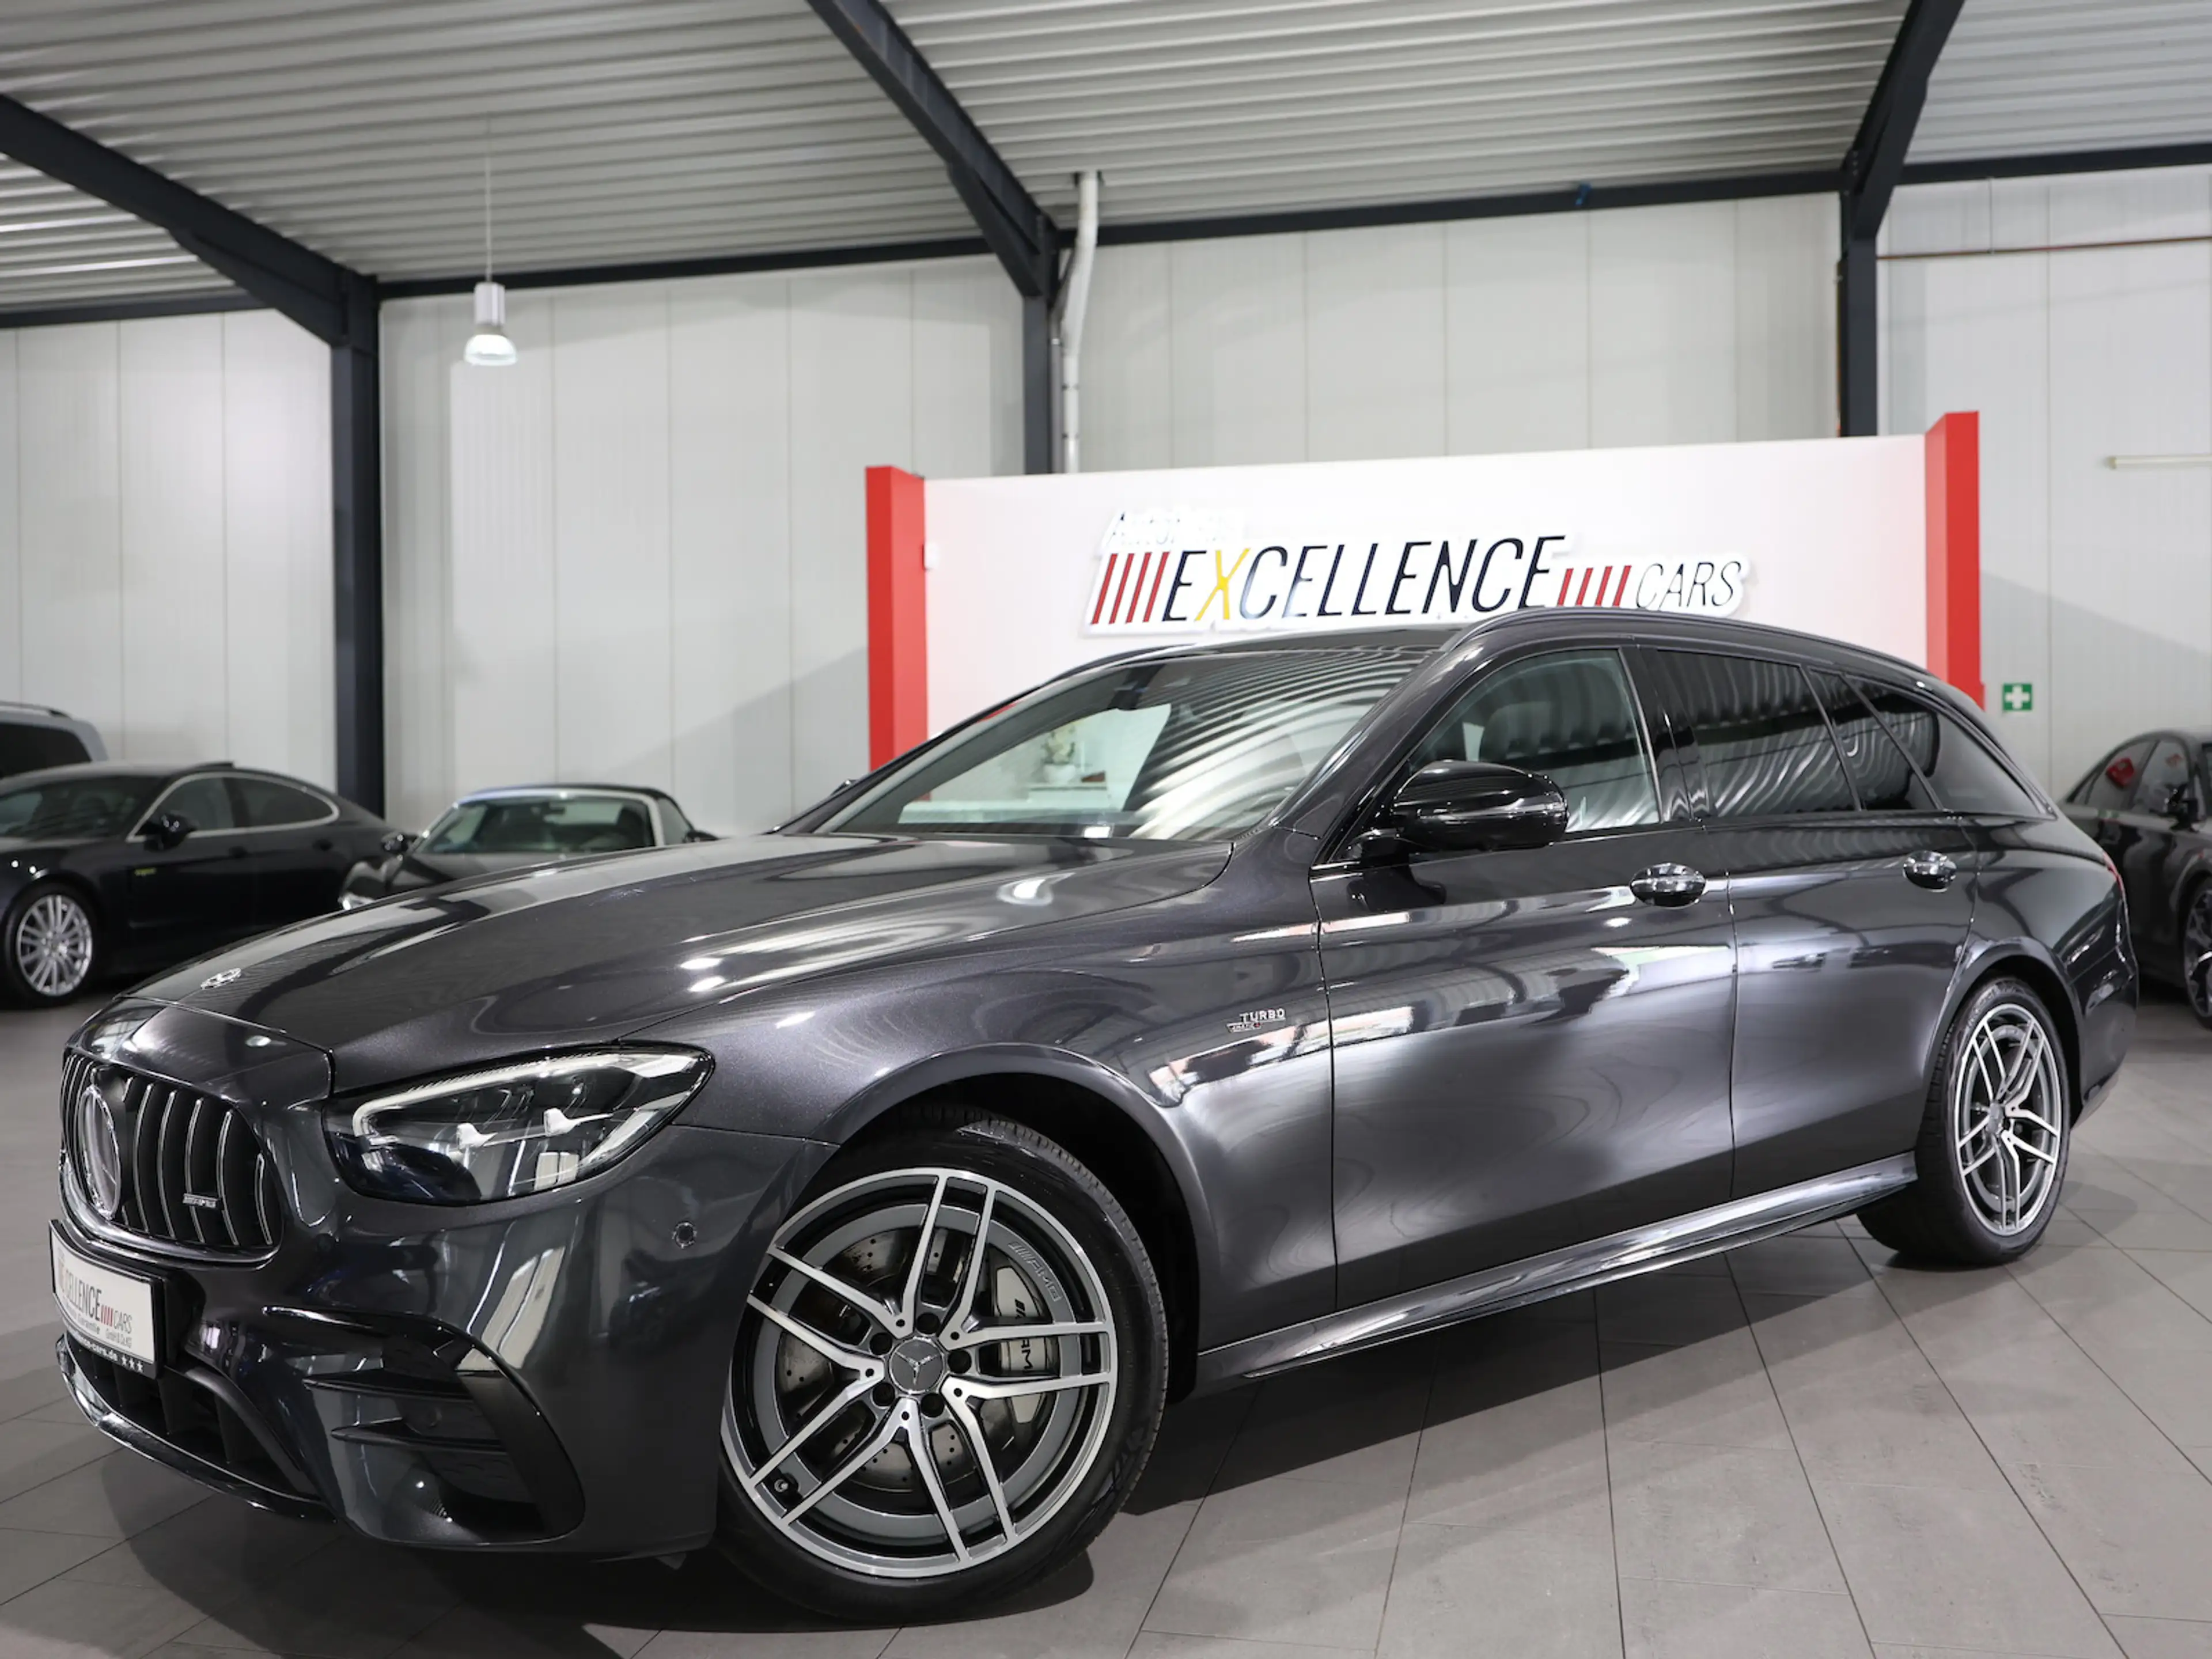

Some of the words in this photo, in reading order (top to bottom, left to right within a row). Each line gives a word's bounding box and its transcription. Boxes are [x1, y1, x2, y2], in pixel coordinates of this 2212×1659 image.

[1161, 535, 1566, 622] EXCELLENCE
[1635, 560, 1742, 611] CARS
[1239, 1008, 1285, 1023] TURBO
[113, 1309, 132, 1334] CARS
